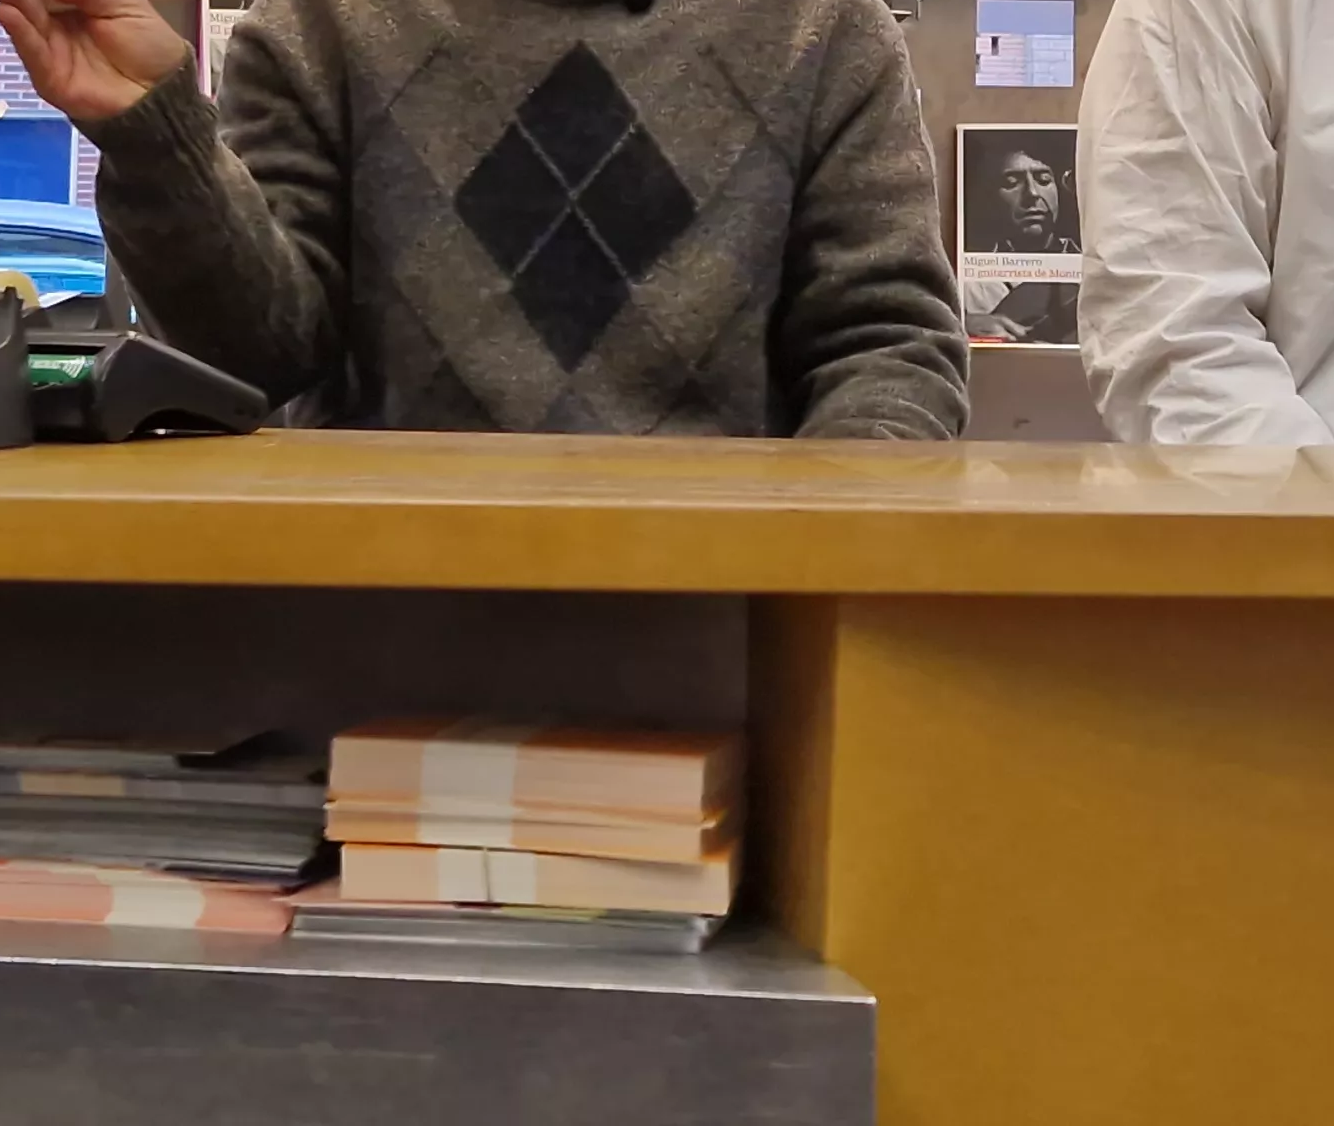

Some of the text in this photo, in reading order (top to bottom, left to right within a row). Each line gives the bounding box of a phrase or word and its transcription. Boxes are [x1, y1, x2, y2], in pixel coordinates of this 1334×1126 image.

[210, 13, 237, 23] Migu
[964, 257, 1042, 267] Miguel Barrero
[1034, 268, 1046, 277] de
[1048, 269, 1082, 278] Montr
